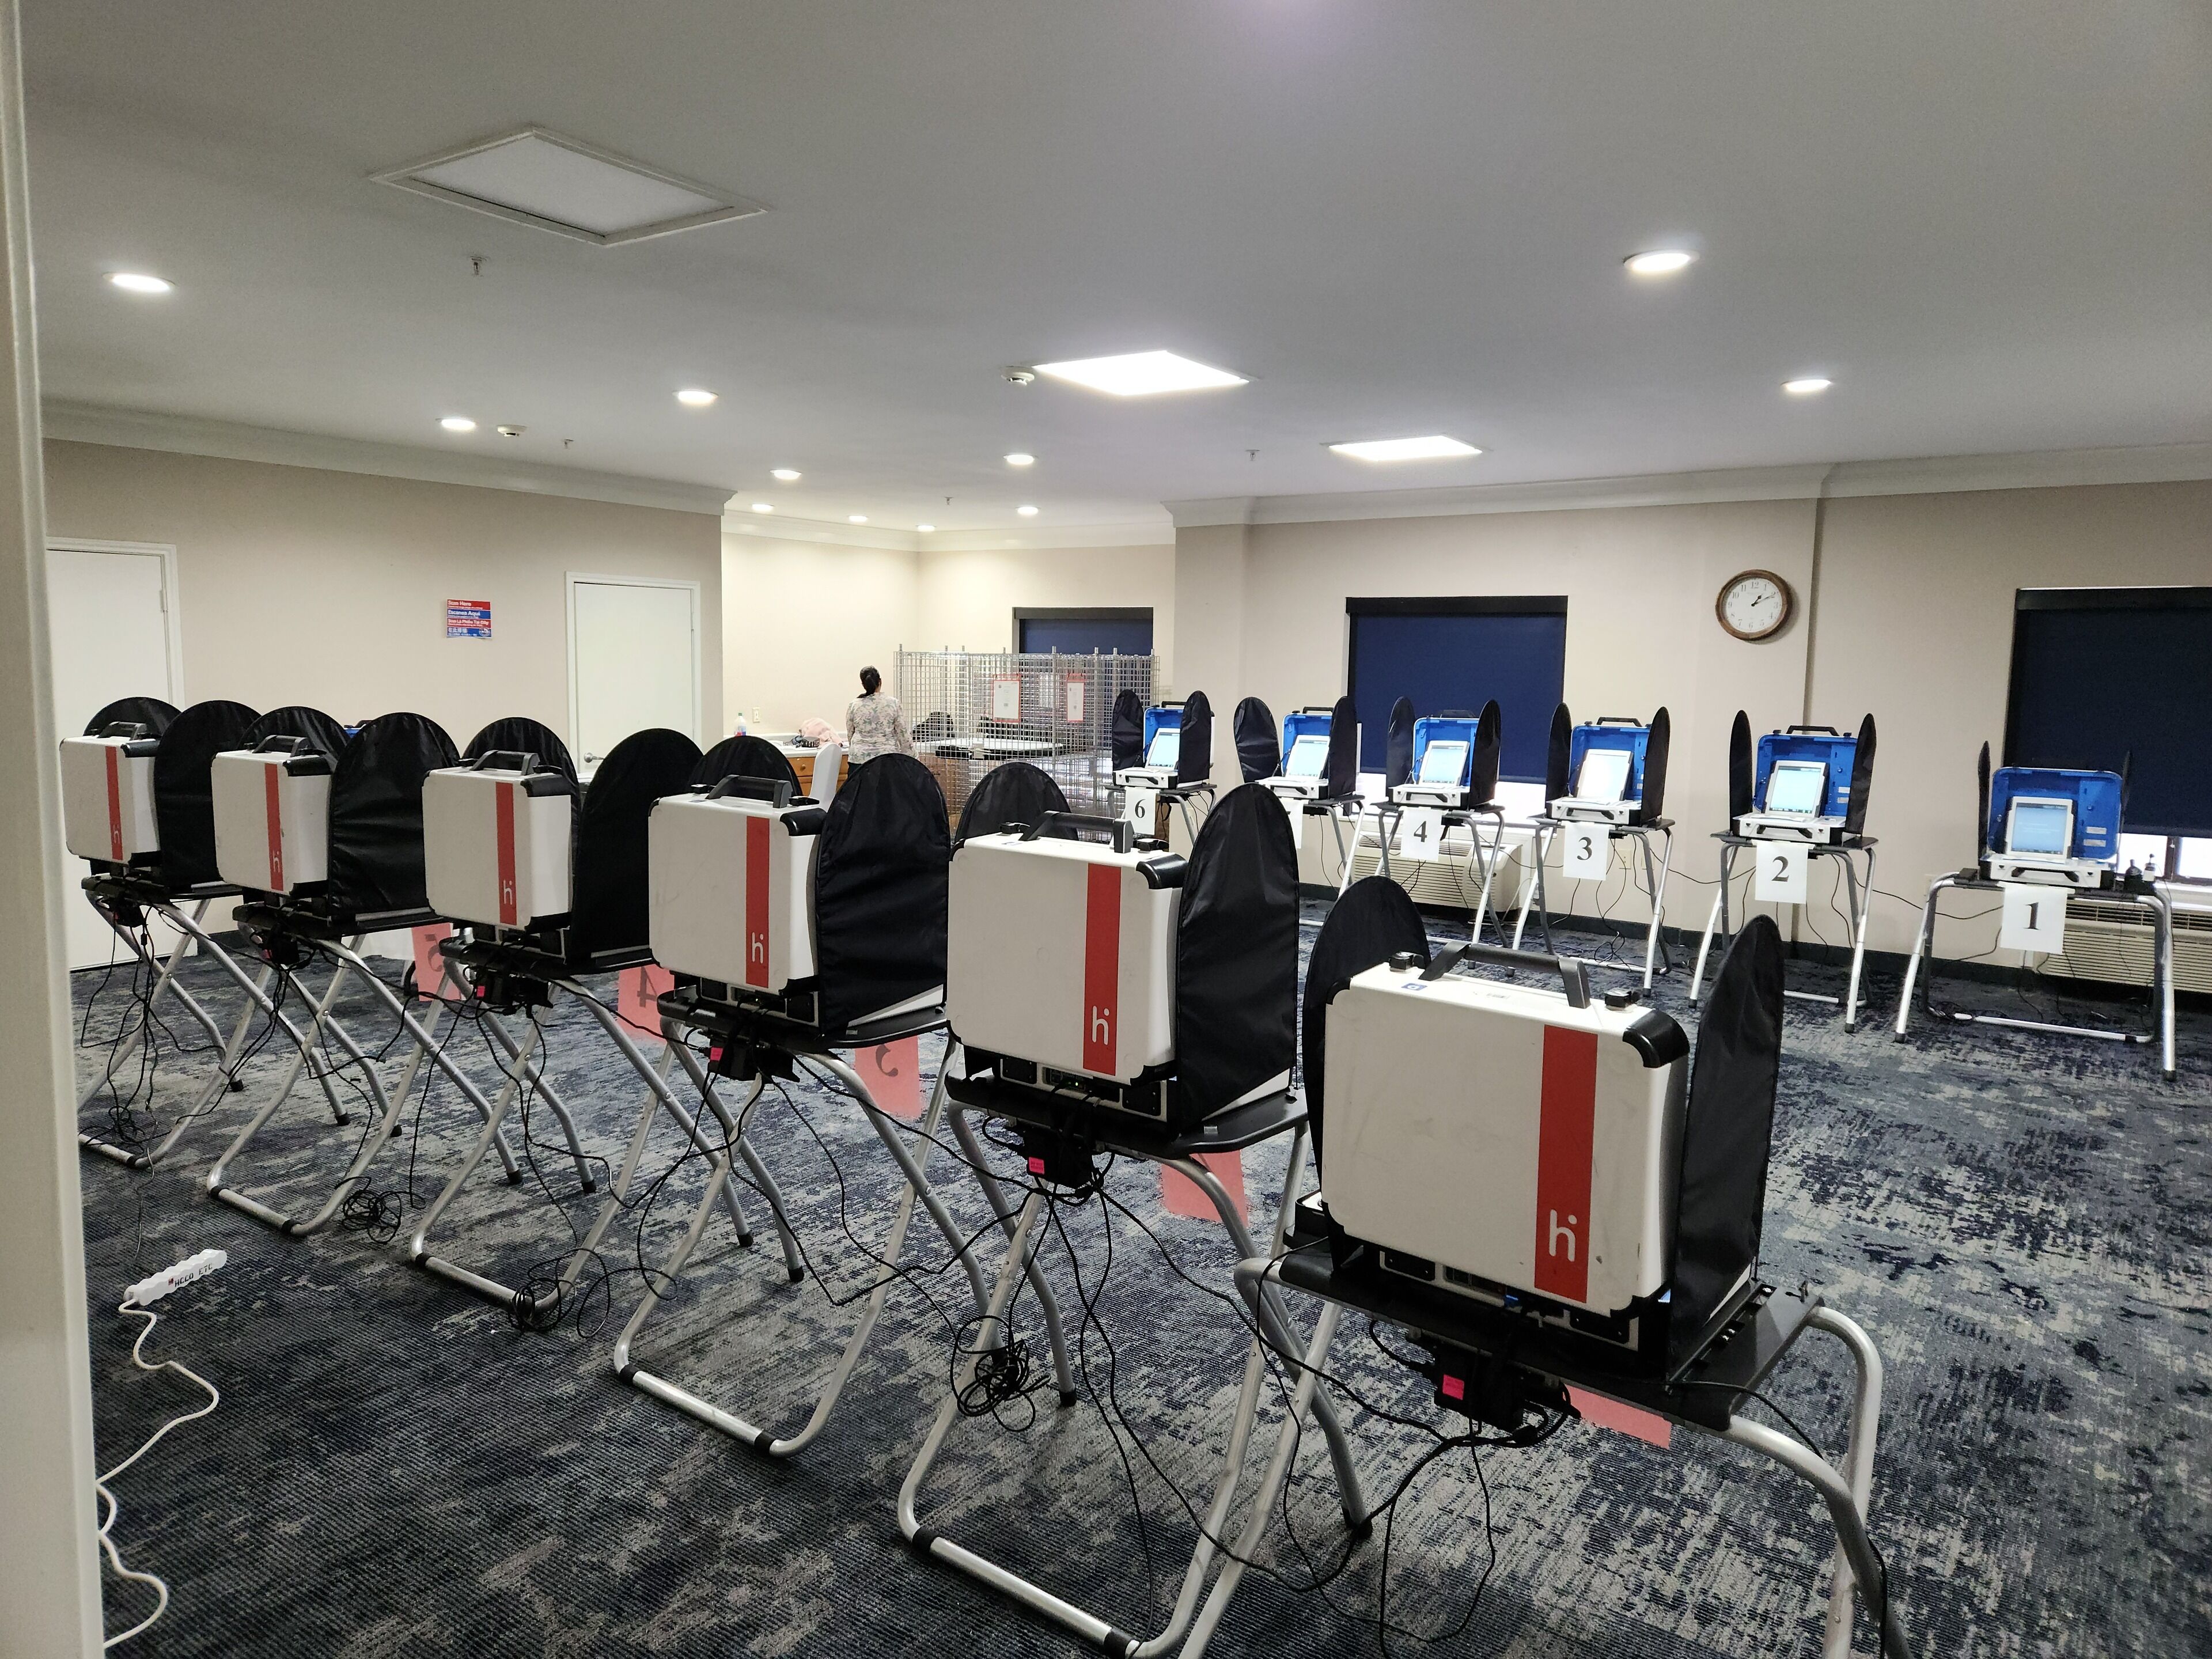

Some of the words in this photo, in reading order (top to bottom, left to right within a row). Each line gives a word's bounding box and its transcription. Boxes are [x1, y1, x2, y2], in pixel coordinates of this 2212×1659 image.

[1732, 591, 1739, 599] 10
[1135, 799, 1146, 819] 6
[1414, 820, 1427, 843] 4
[1577, 836, 1592, 861] 3
[1771, 856, 1789, 882] 2
[2026, 902, 2039, 930] 1
[199, 1263, 213, 1275] ETC
